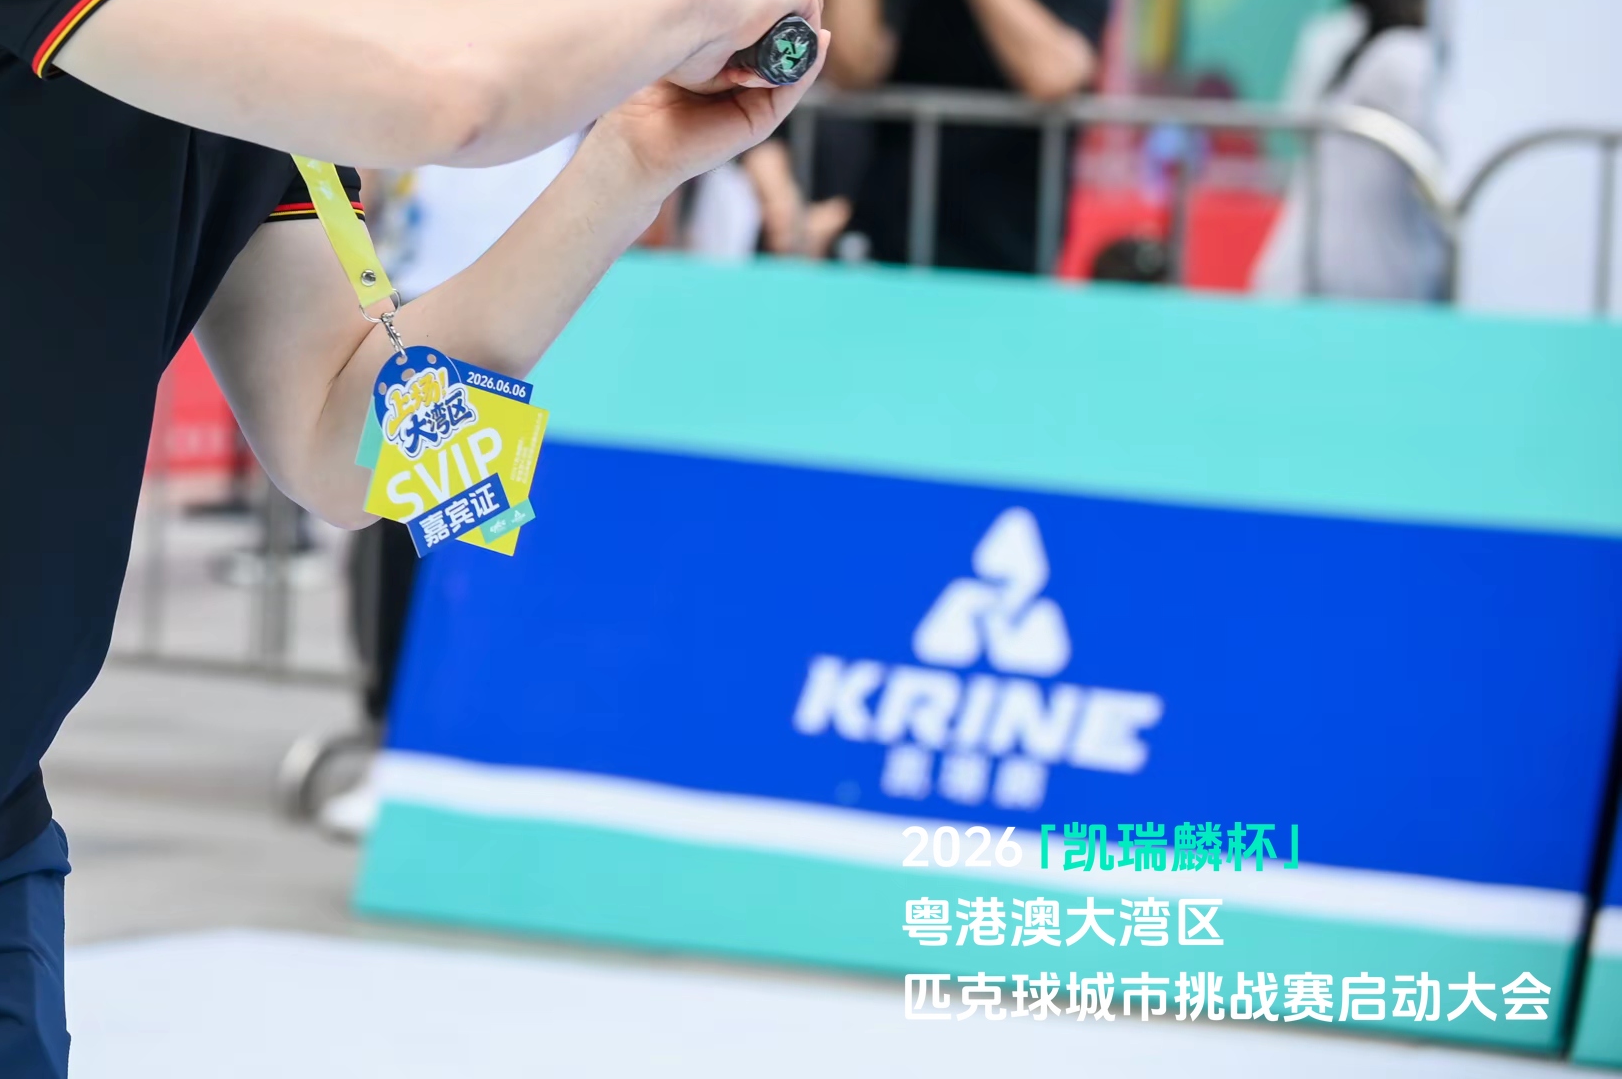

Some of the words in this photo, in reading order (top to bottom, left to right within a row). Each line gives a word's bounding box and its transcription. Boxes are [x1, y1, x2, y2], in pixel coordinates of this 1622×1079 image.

[466, 371, 527, 399] 2026.06.06
[404, 394, 473, 453] 大湾区
[386, 426, 503, 523] SVIP
[419, 482, 500, 549] 嘉宾证
[793, 656, 1163, 774] KRINE
